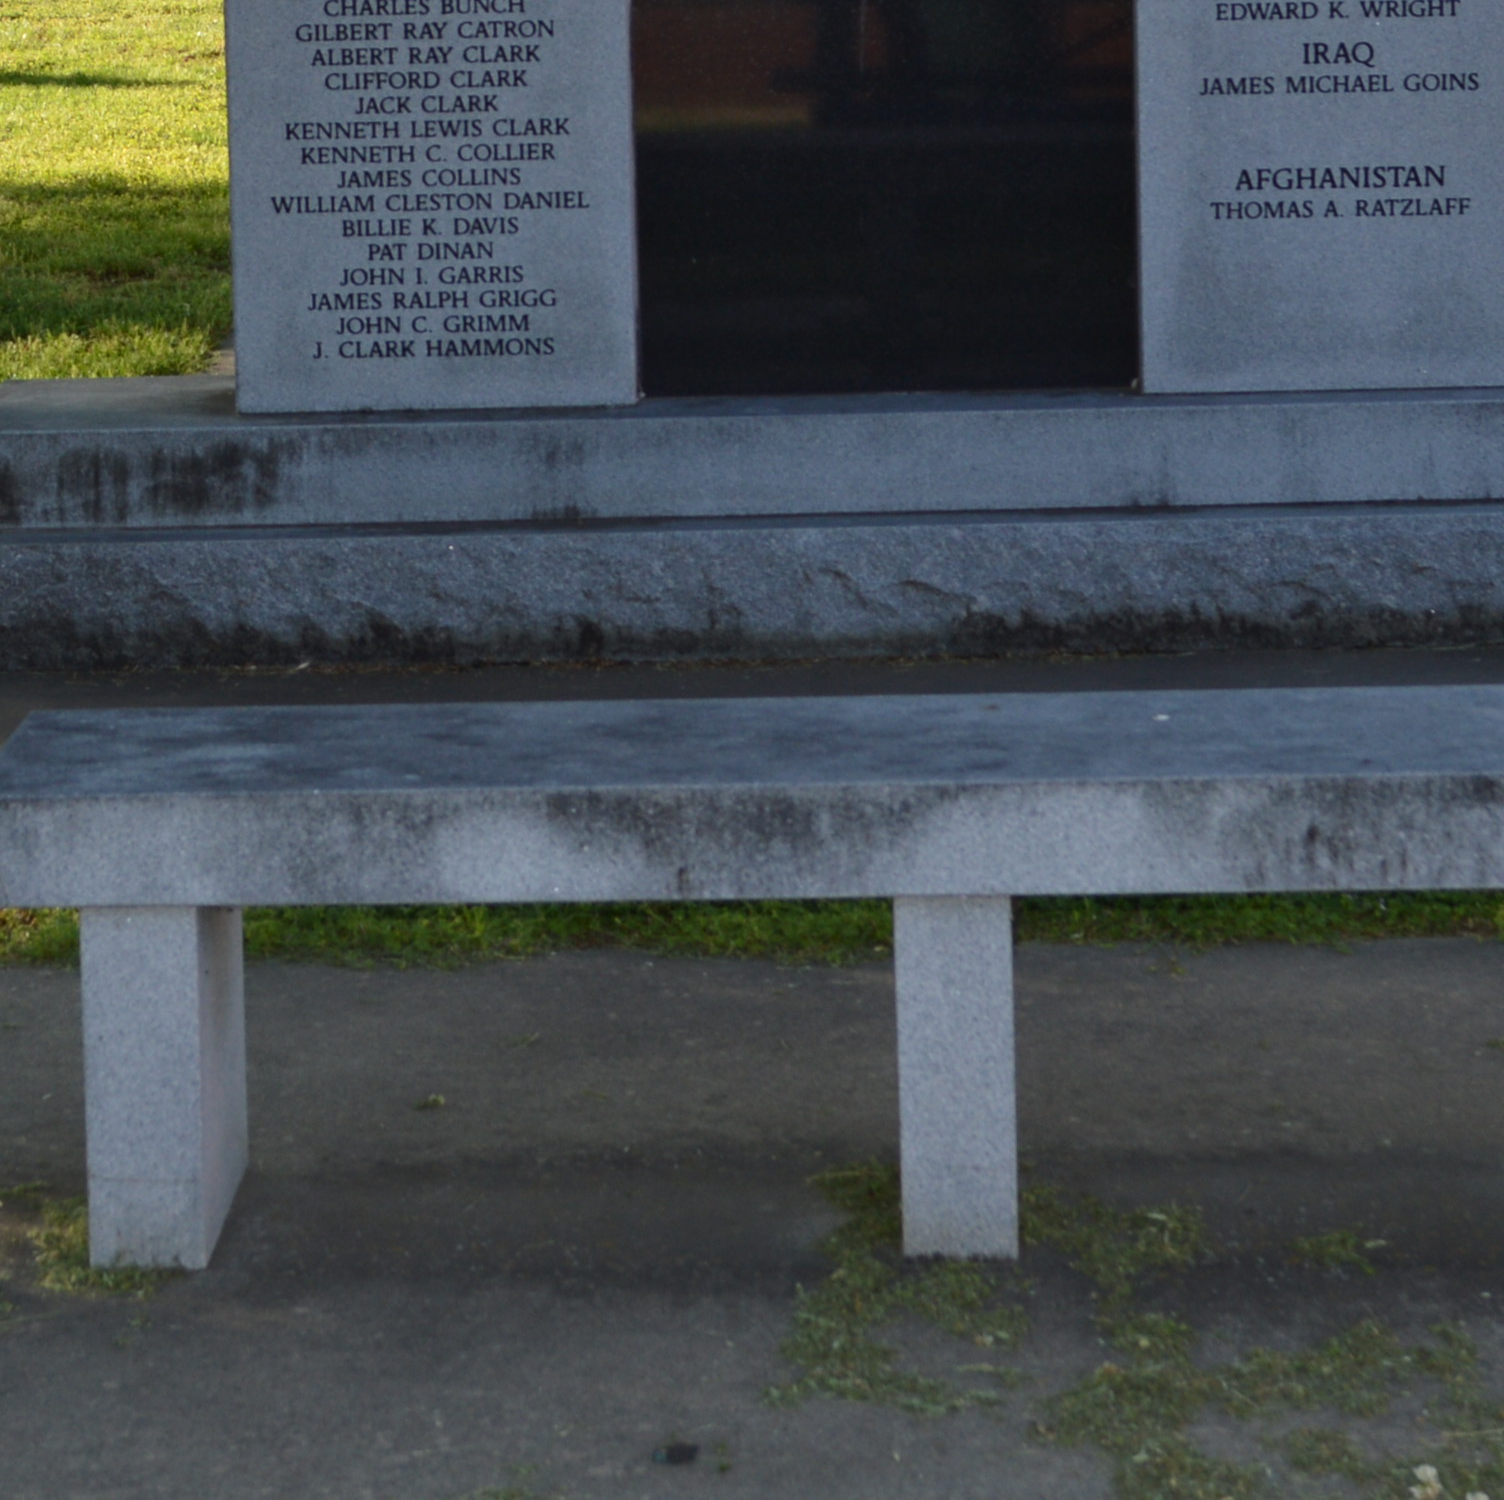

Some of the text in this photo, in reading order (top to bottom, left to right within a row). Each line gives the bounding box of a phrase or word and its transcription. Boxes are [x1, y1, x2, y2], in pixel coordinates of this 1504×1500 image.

[295, 20, 554, 42] GILBERT RAY CATRON
[1303, 42, 1374, 68] IRAQ
[325, 70, 527, 90] CLIFFORD CLARK
[1200, 73, 1479, 96] JAMES MICHAEL GOINS
[355, 95, 498, 114] JACK CLARK
[338, 168, 520, 188] JAMES COLLINS
[1236, 165, 1445, 190] AFGHANISTAN
[271, 191, 589, 214] WILLIAM CLESTON DANIEL
[368, 242, 493, 261] PAT DINAN
[308, 289, 556, 311] JAMES RALPH GRIGG
